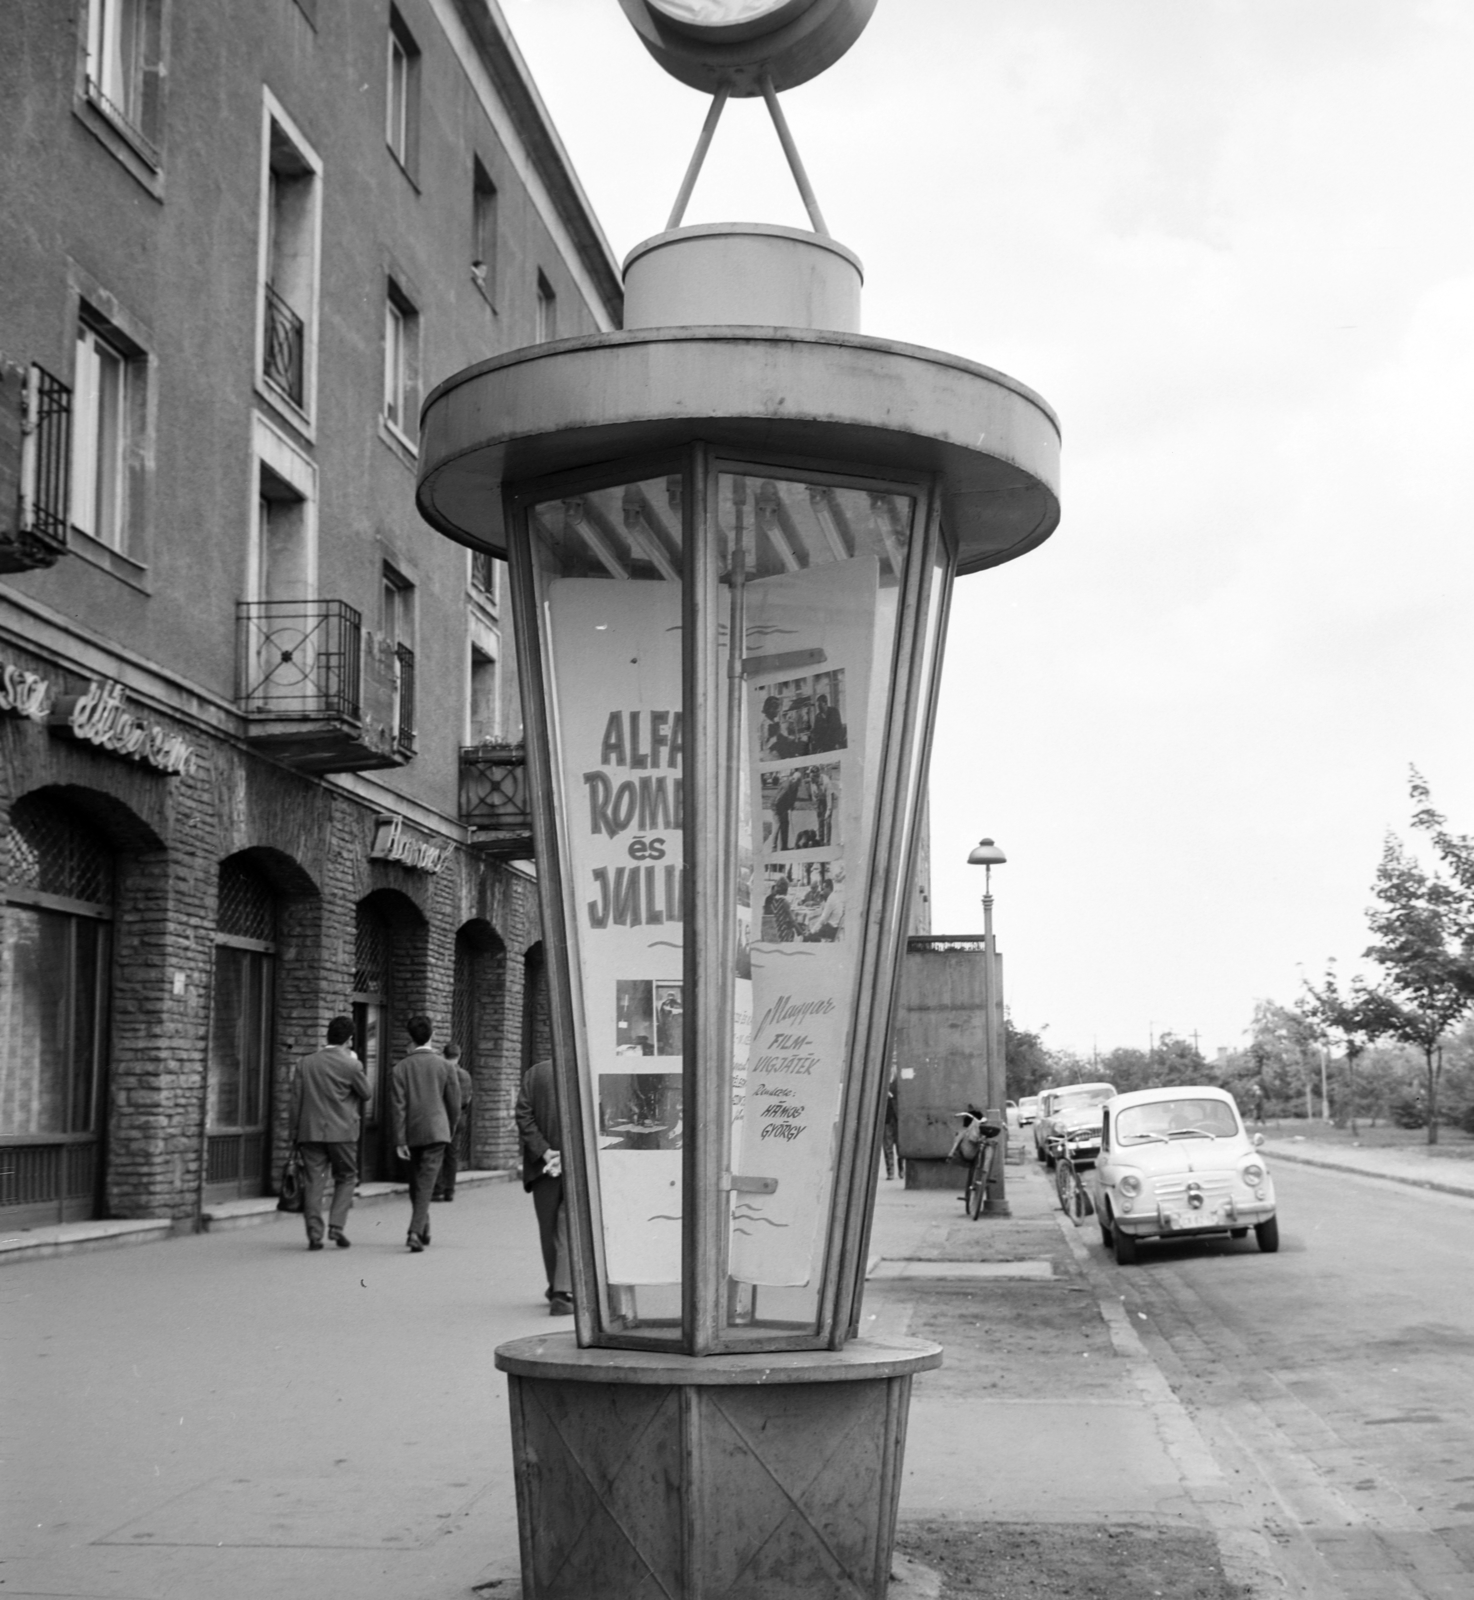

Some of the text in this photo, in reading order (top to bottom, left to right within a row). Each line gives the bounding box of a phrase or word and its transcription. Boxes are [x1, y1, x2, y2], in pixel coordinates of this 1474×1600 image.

[601, 710, 683, 769] ALFA
[583, 770, 683, 840] ROME
[628, 836, 666, 861] és
[587, 864, 683, 929] JULI
[753, 995, 836, 1041] Magyar
[767, 1033, 813, 1050] FILM-
